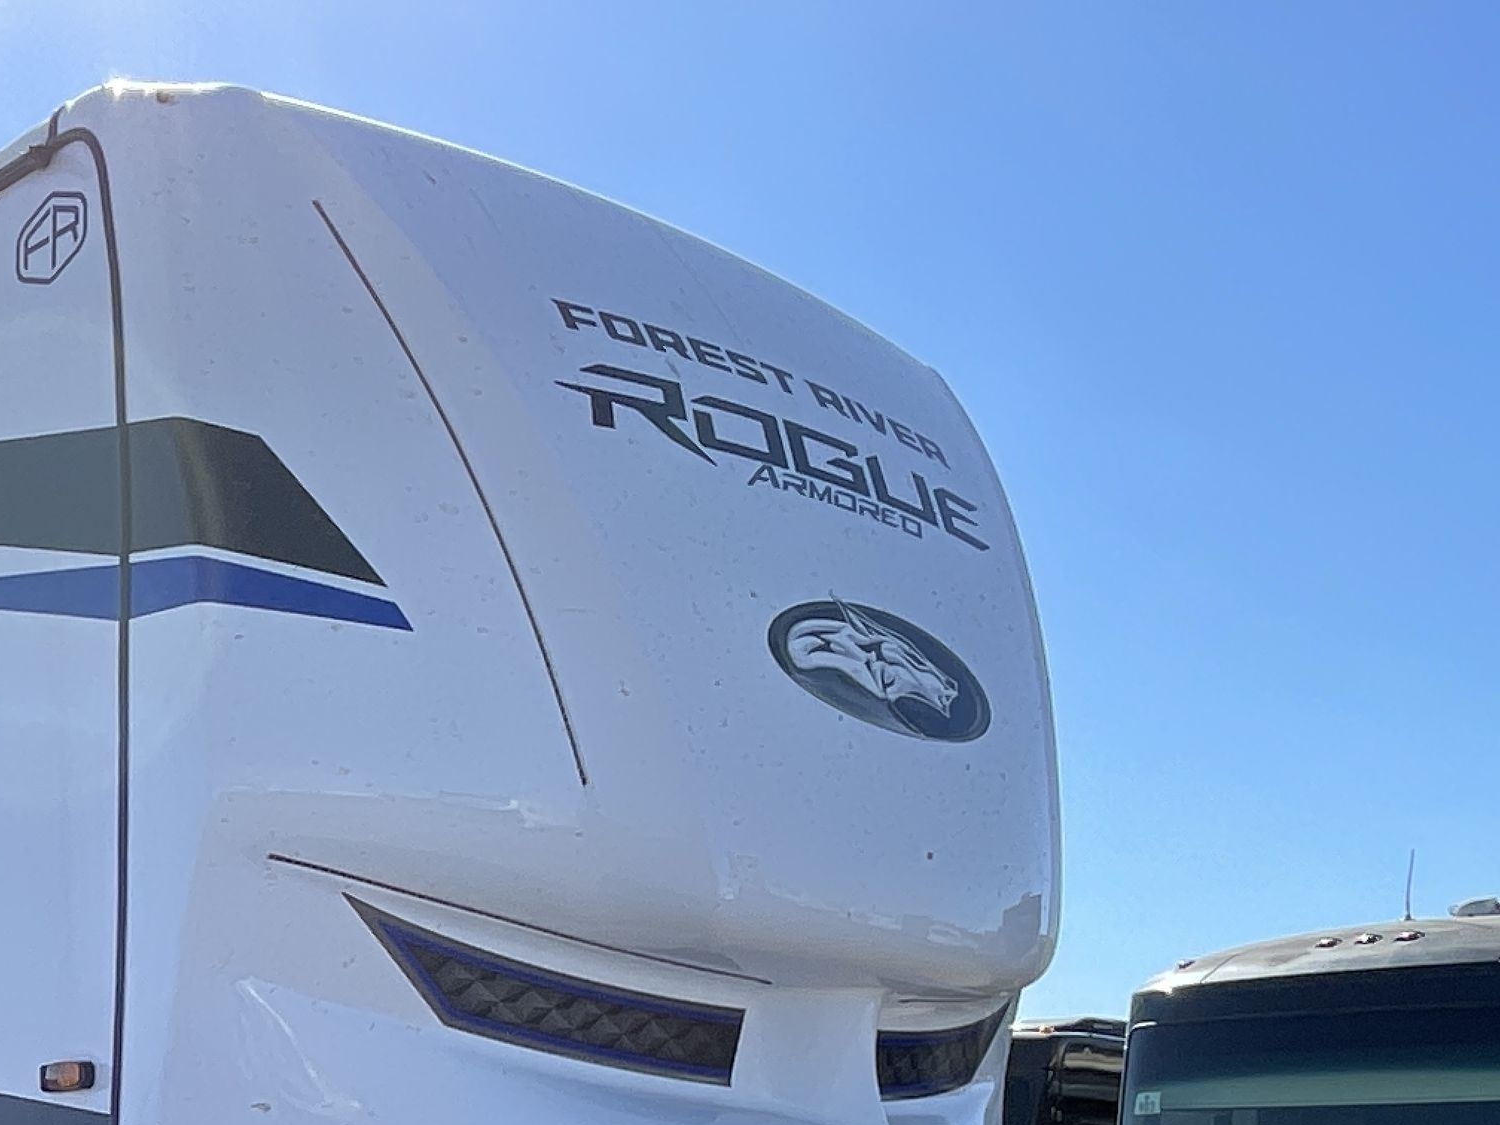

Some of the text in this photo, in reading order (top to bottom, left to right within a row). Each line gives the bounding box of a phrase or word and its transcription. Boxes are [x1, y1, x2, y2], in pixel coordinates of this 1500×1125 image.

[551, 298, 950, 469] FOREST RIVER
[554, 363, 990, 552] ROGUE
[747, 463, 923, 539] ARMORED
